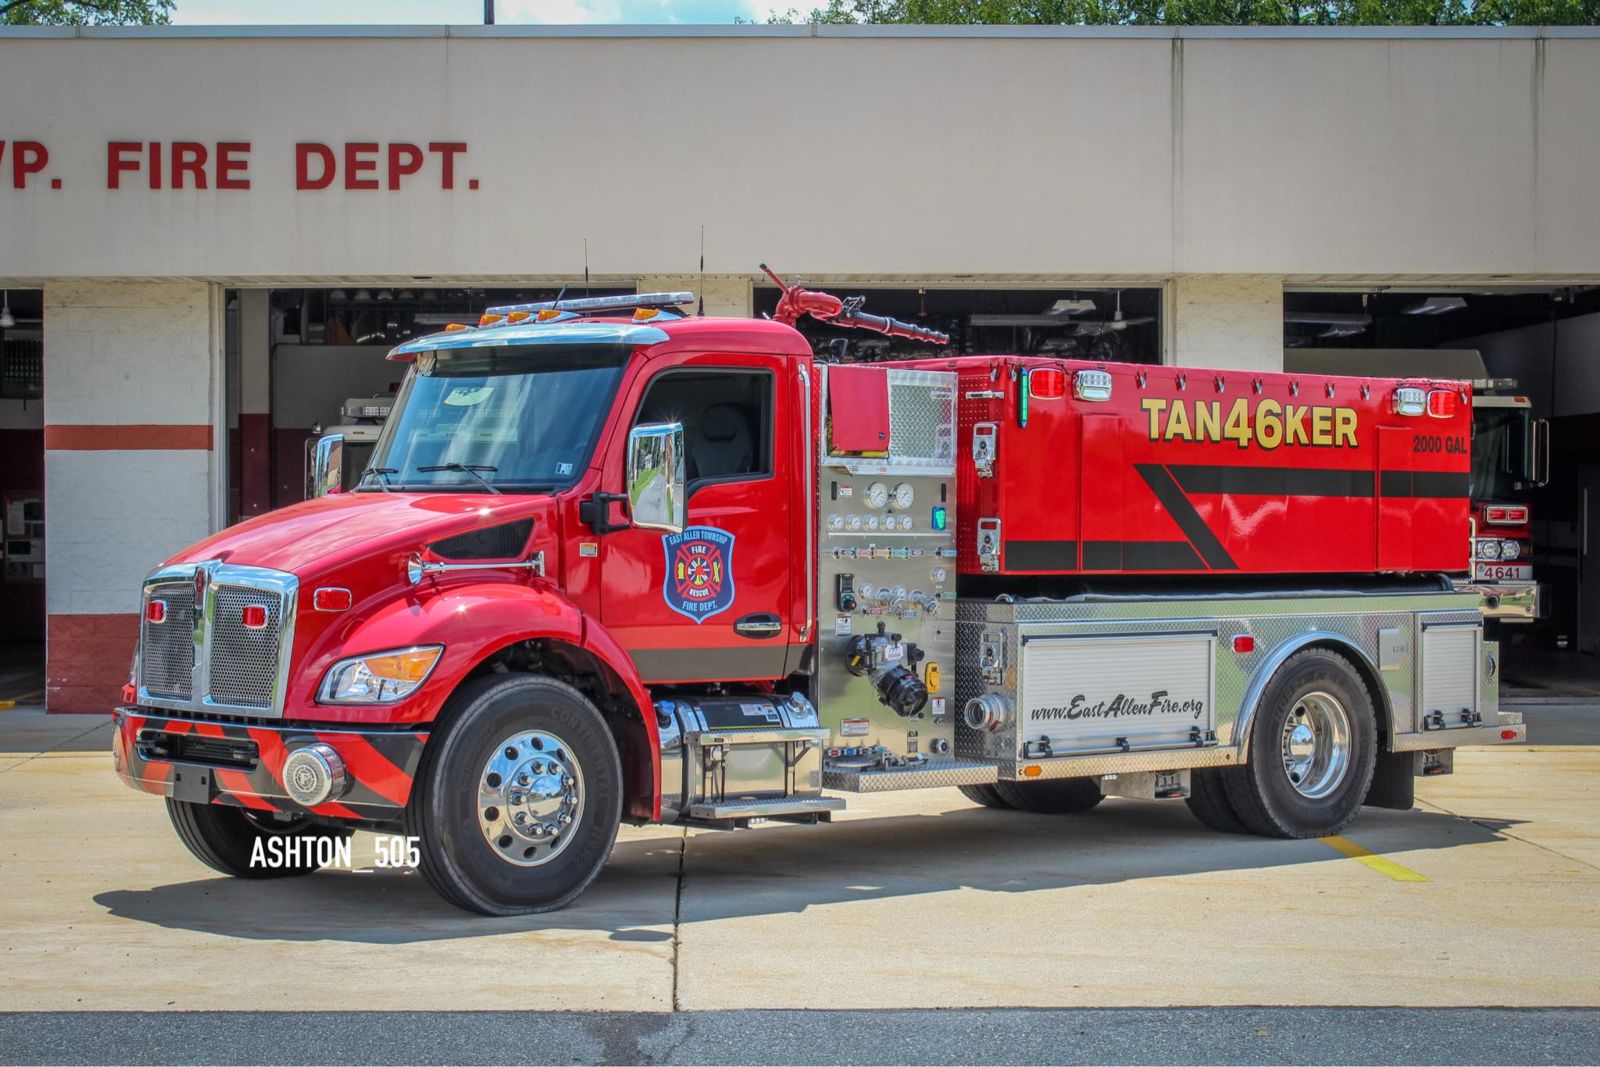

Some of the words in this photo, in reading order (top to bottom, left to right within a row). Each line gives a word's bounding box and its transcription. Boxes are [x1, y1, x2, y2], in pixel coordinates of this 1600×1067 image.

[0, 140, 62, 190] P.
[107, 141, 251, 190] FIRE
[295, 142, 480, 191] DEPT.
[1413, 435, 1442, 453] 2000
[1446, 435, 1468, 454] GAL
[669, 533, 683, 545] EAST
[683, 530, 700, 541] ALLEN
[701, 530, 728, 545] TOWNSHIP
[691, 545, 707, 554] FIRE
[1484, 567, 1520, 579] 4641
[689, 588, 710, 597] RESCUE
[682, 600, 698, 612] FIRE
[699, 600, 718, 612] DEPT.
[1031, 690, 1204, 720] www.EastAllenFire.org
